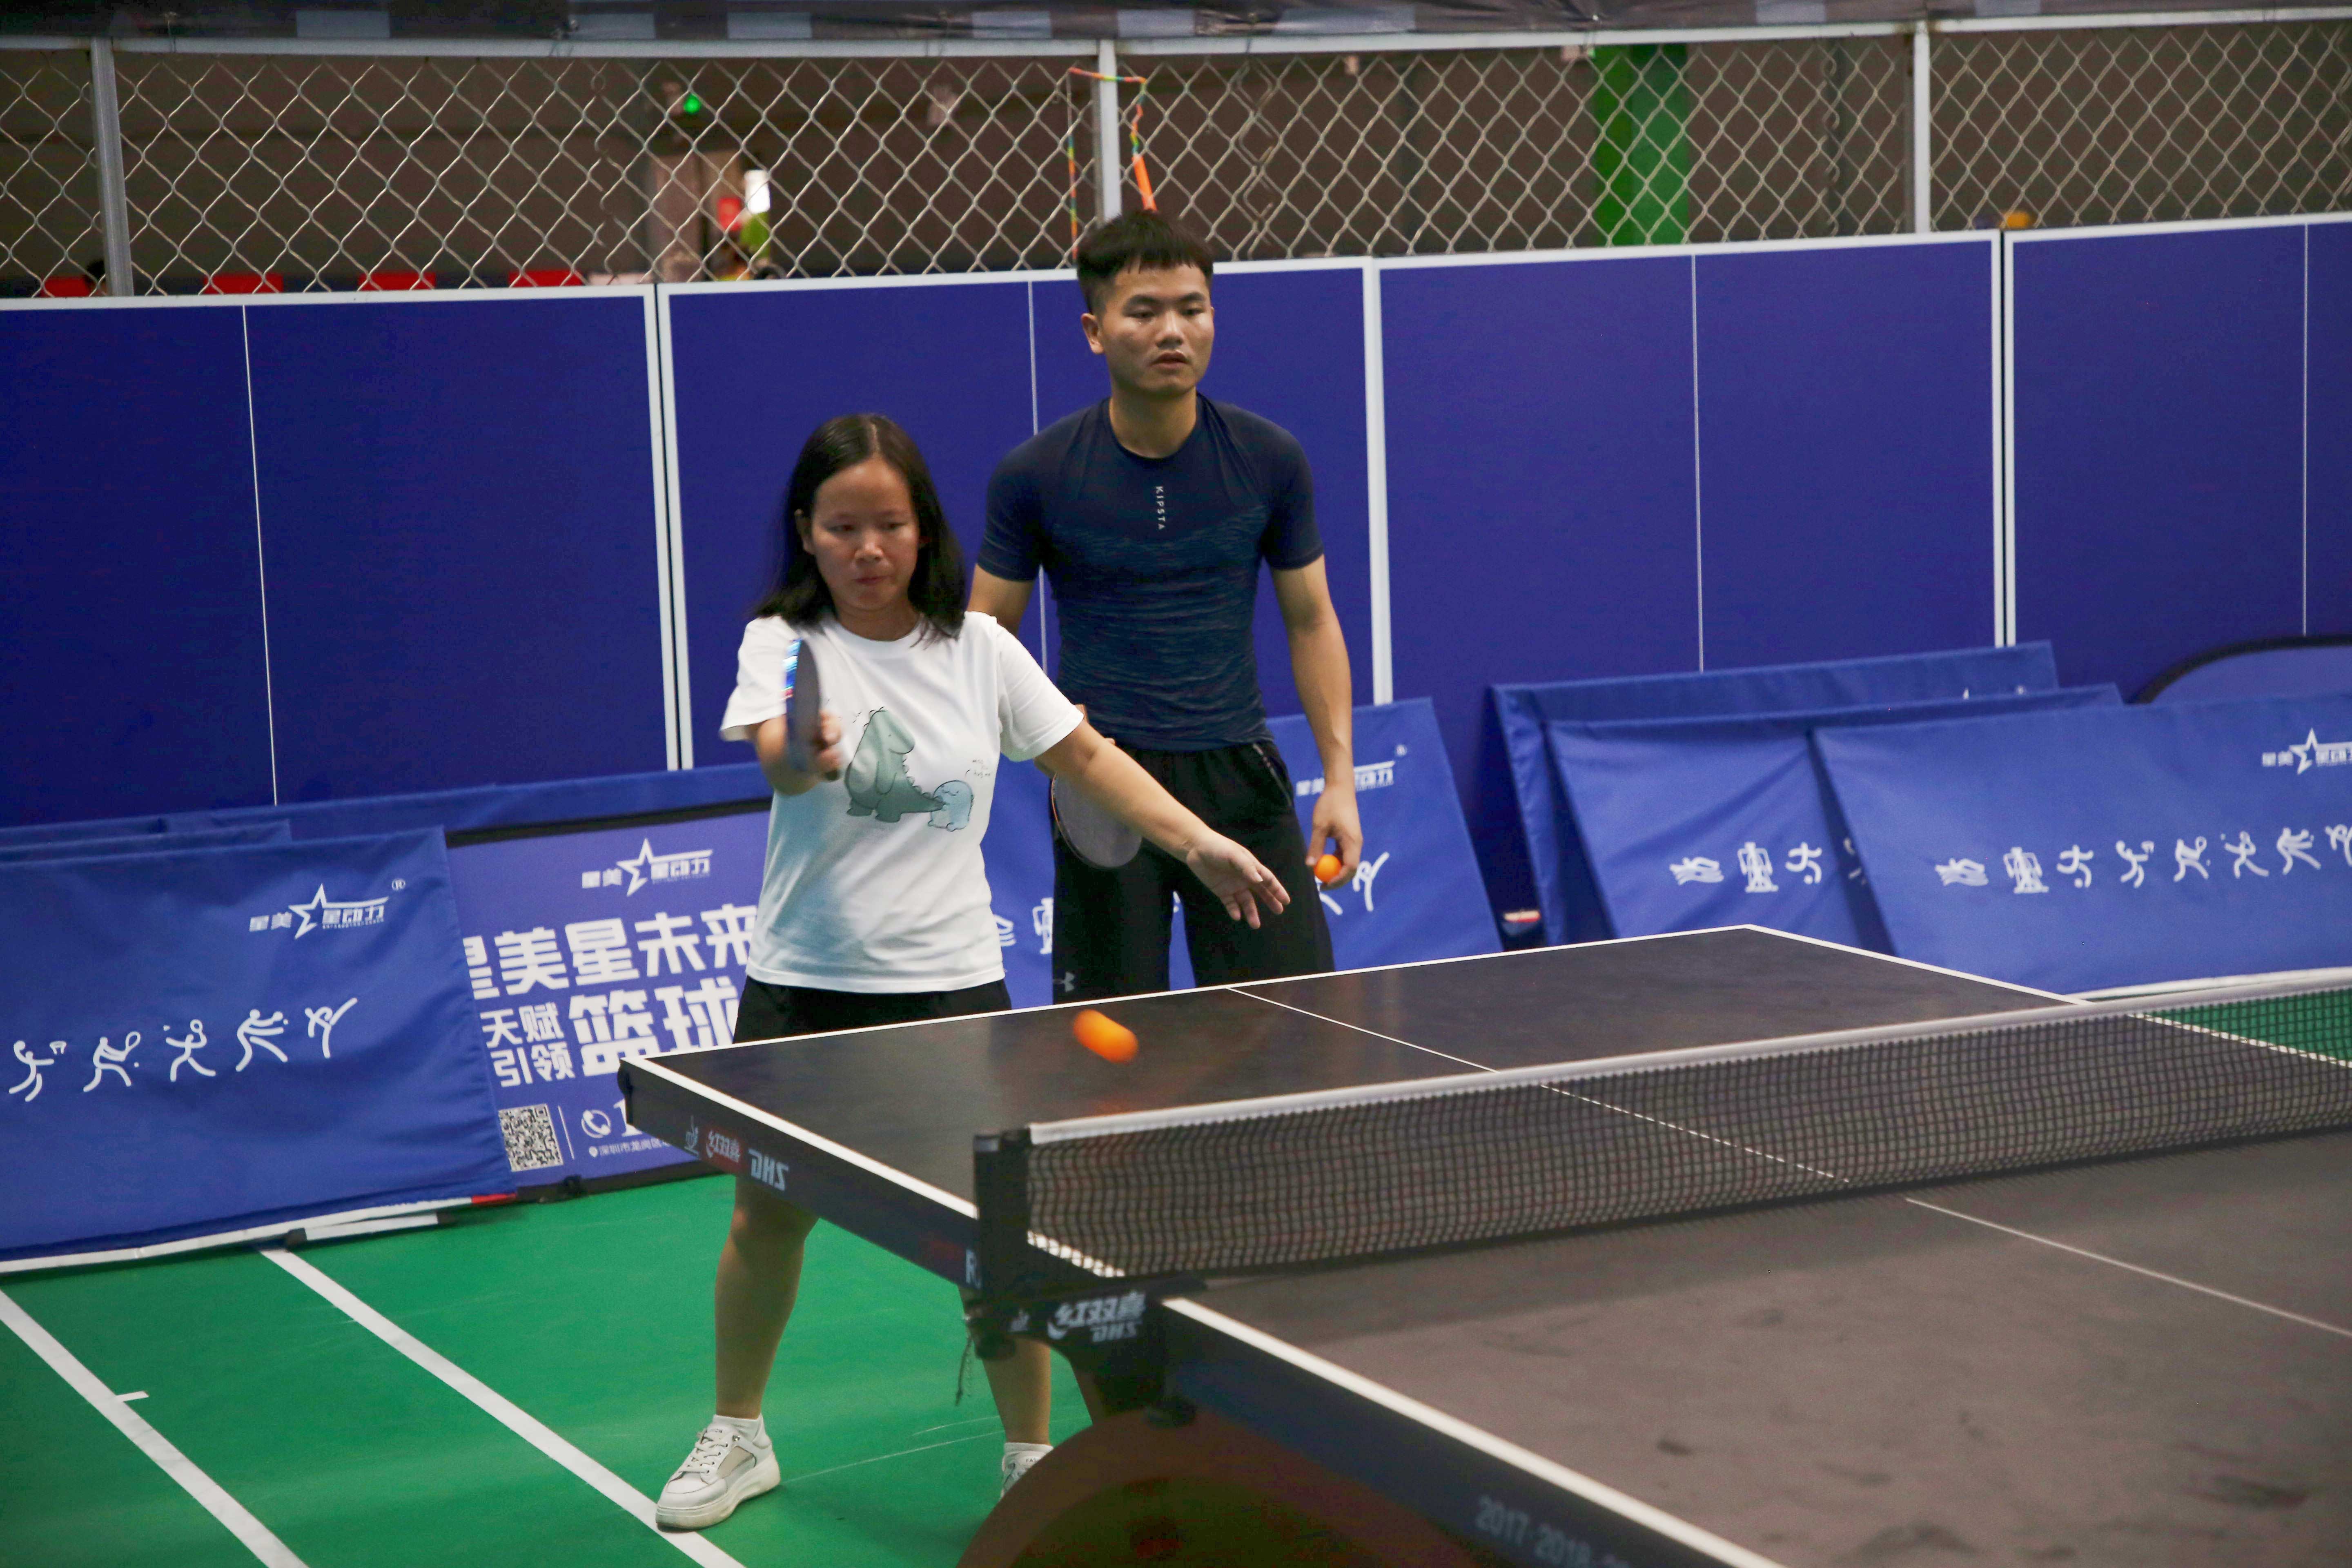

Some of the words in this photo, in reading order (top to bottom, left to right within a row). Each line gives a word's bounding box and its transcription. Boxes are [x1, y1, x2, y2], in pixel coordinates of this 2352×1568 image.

[1156, 486, 1165, 530] KIPSTA
[480, 1002, 564, 1048] 天赋
[569, 976, 739, 1077] 篮球
[490, 1041, 576, 1087] 引领
[748, 1148, 789, 1192] DHS
